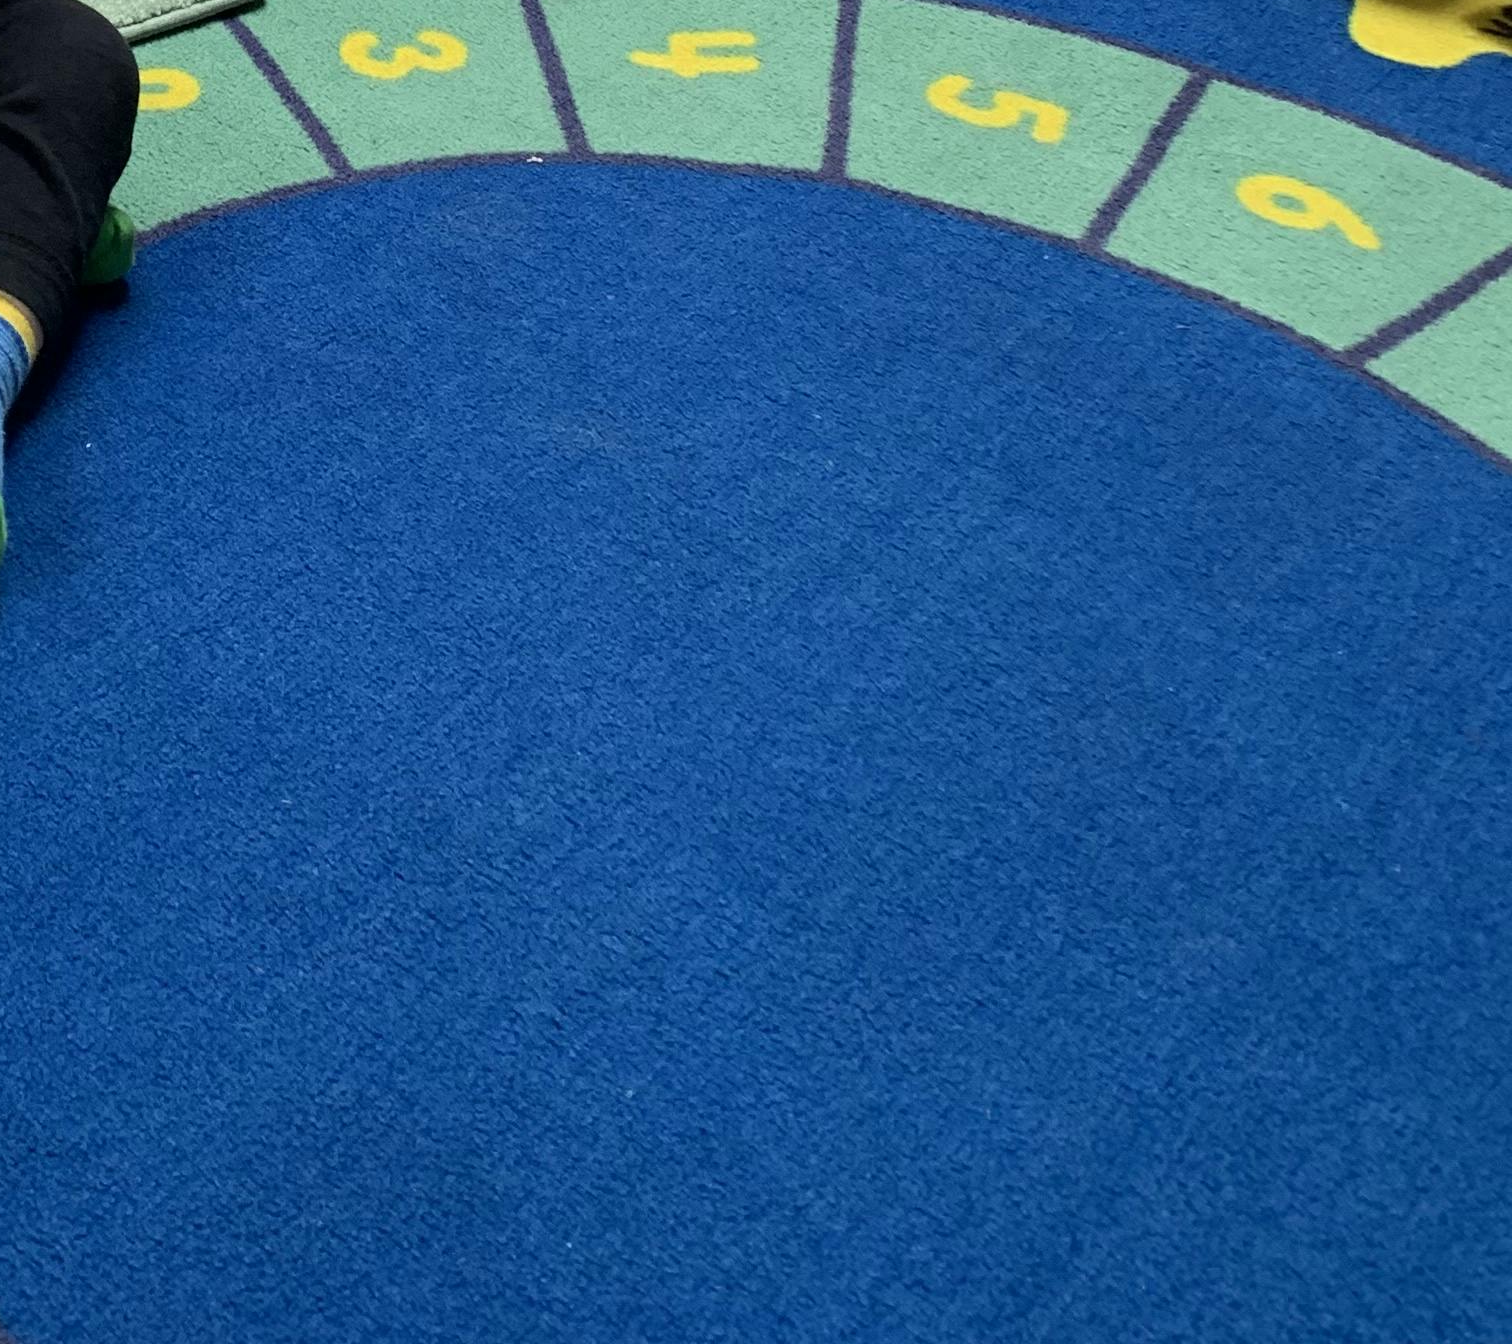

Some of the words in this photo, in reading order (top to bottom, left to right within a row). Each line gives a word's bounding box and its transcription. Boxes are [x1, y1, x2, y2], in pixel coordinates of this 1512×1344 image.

[339, 29, 468, 81] 3
[629, 29, 760, 79] 4
[927, 73, 1069, 146] 5
[1235, 173, 1383, 251] 6
